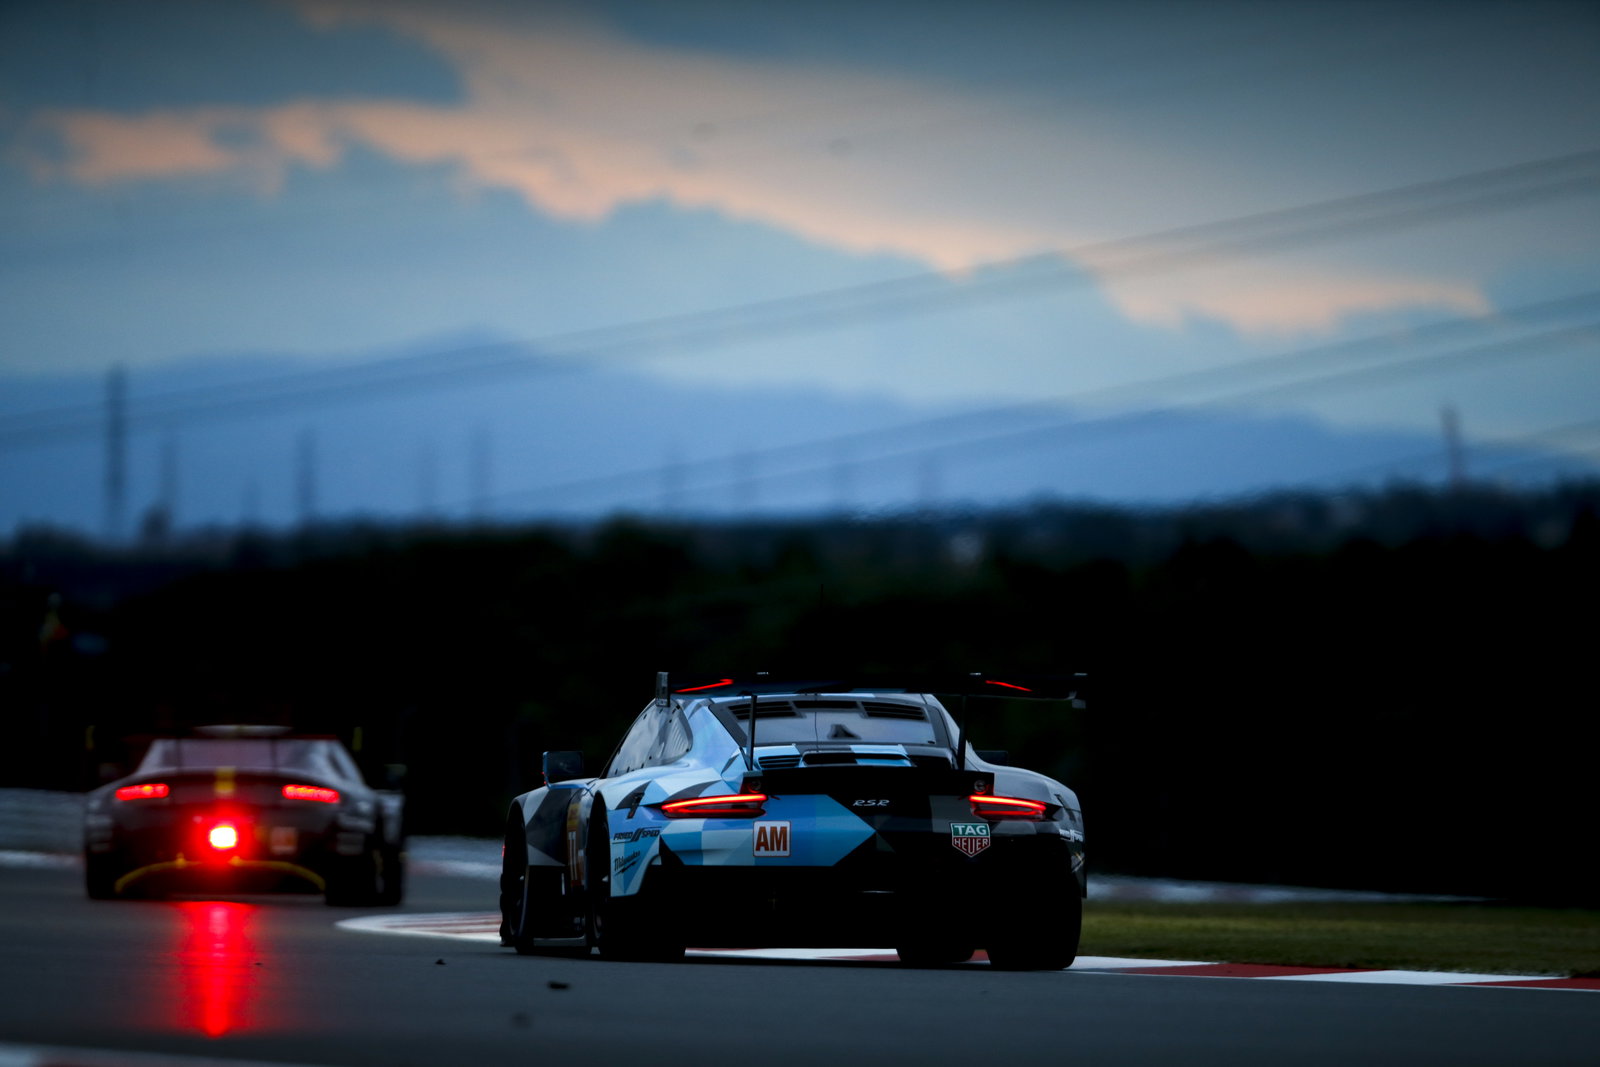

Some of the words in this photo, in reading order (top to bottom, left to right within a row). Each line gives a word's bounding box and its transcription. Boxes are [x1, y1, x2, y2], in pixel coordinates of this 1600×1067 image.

[853, 799, 890, 807] RSR
[953, 825, 988, 836] TAG
[755, 826, 788, 852] AM
[954, 837, 989, 855] HEUER
